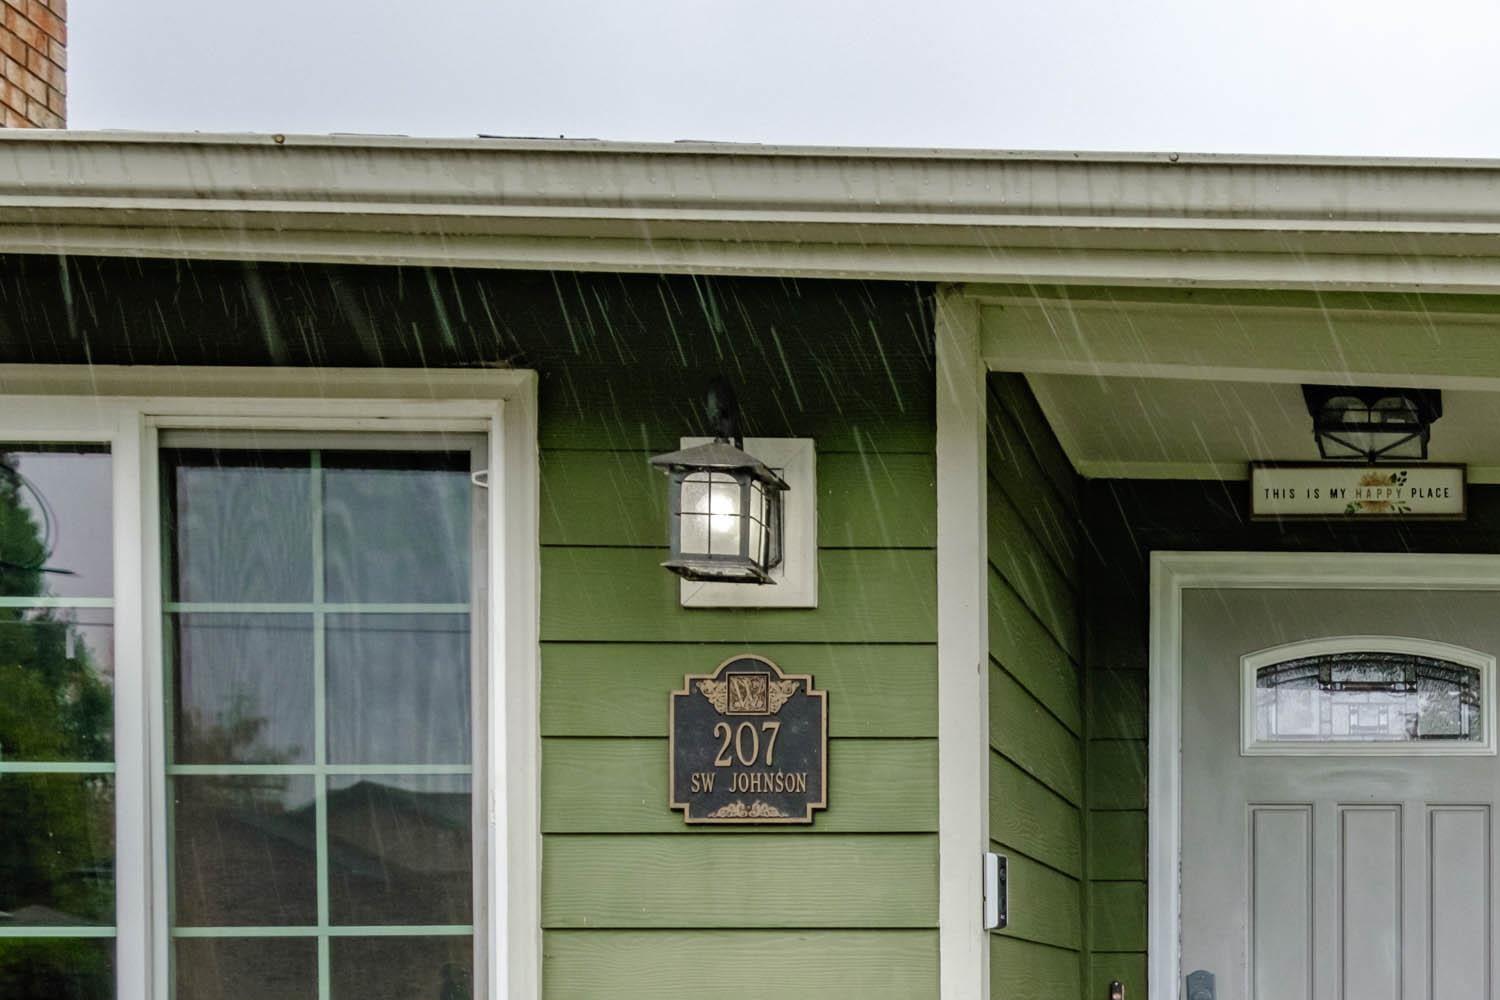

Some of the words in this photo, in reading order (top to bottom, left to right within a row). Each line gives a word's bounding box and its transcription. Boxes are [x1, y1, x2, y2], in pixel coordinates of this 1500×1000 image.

[1264, 488, 1296, 500] THIS
[1306, 488, 1320, 499] IS
[1329, 487, 1347, 499] MY
[1355, 487, 1402, 498] HAPPY
[1411, 487, 1450, 498] PLACE
[713, 721, 781, 767] 207
[691, 772, 715, 793] SW
[729, 772, 807, 793] JOHNSON
